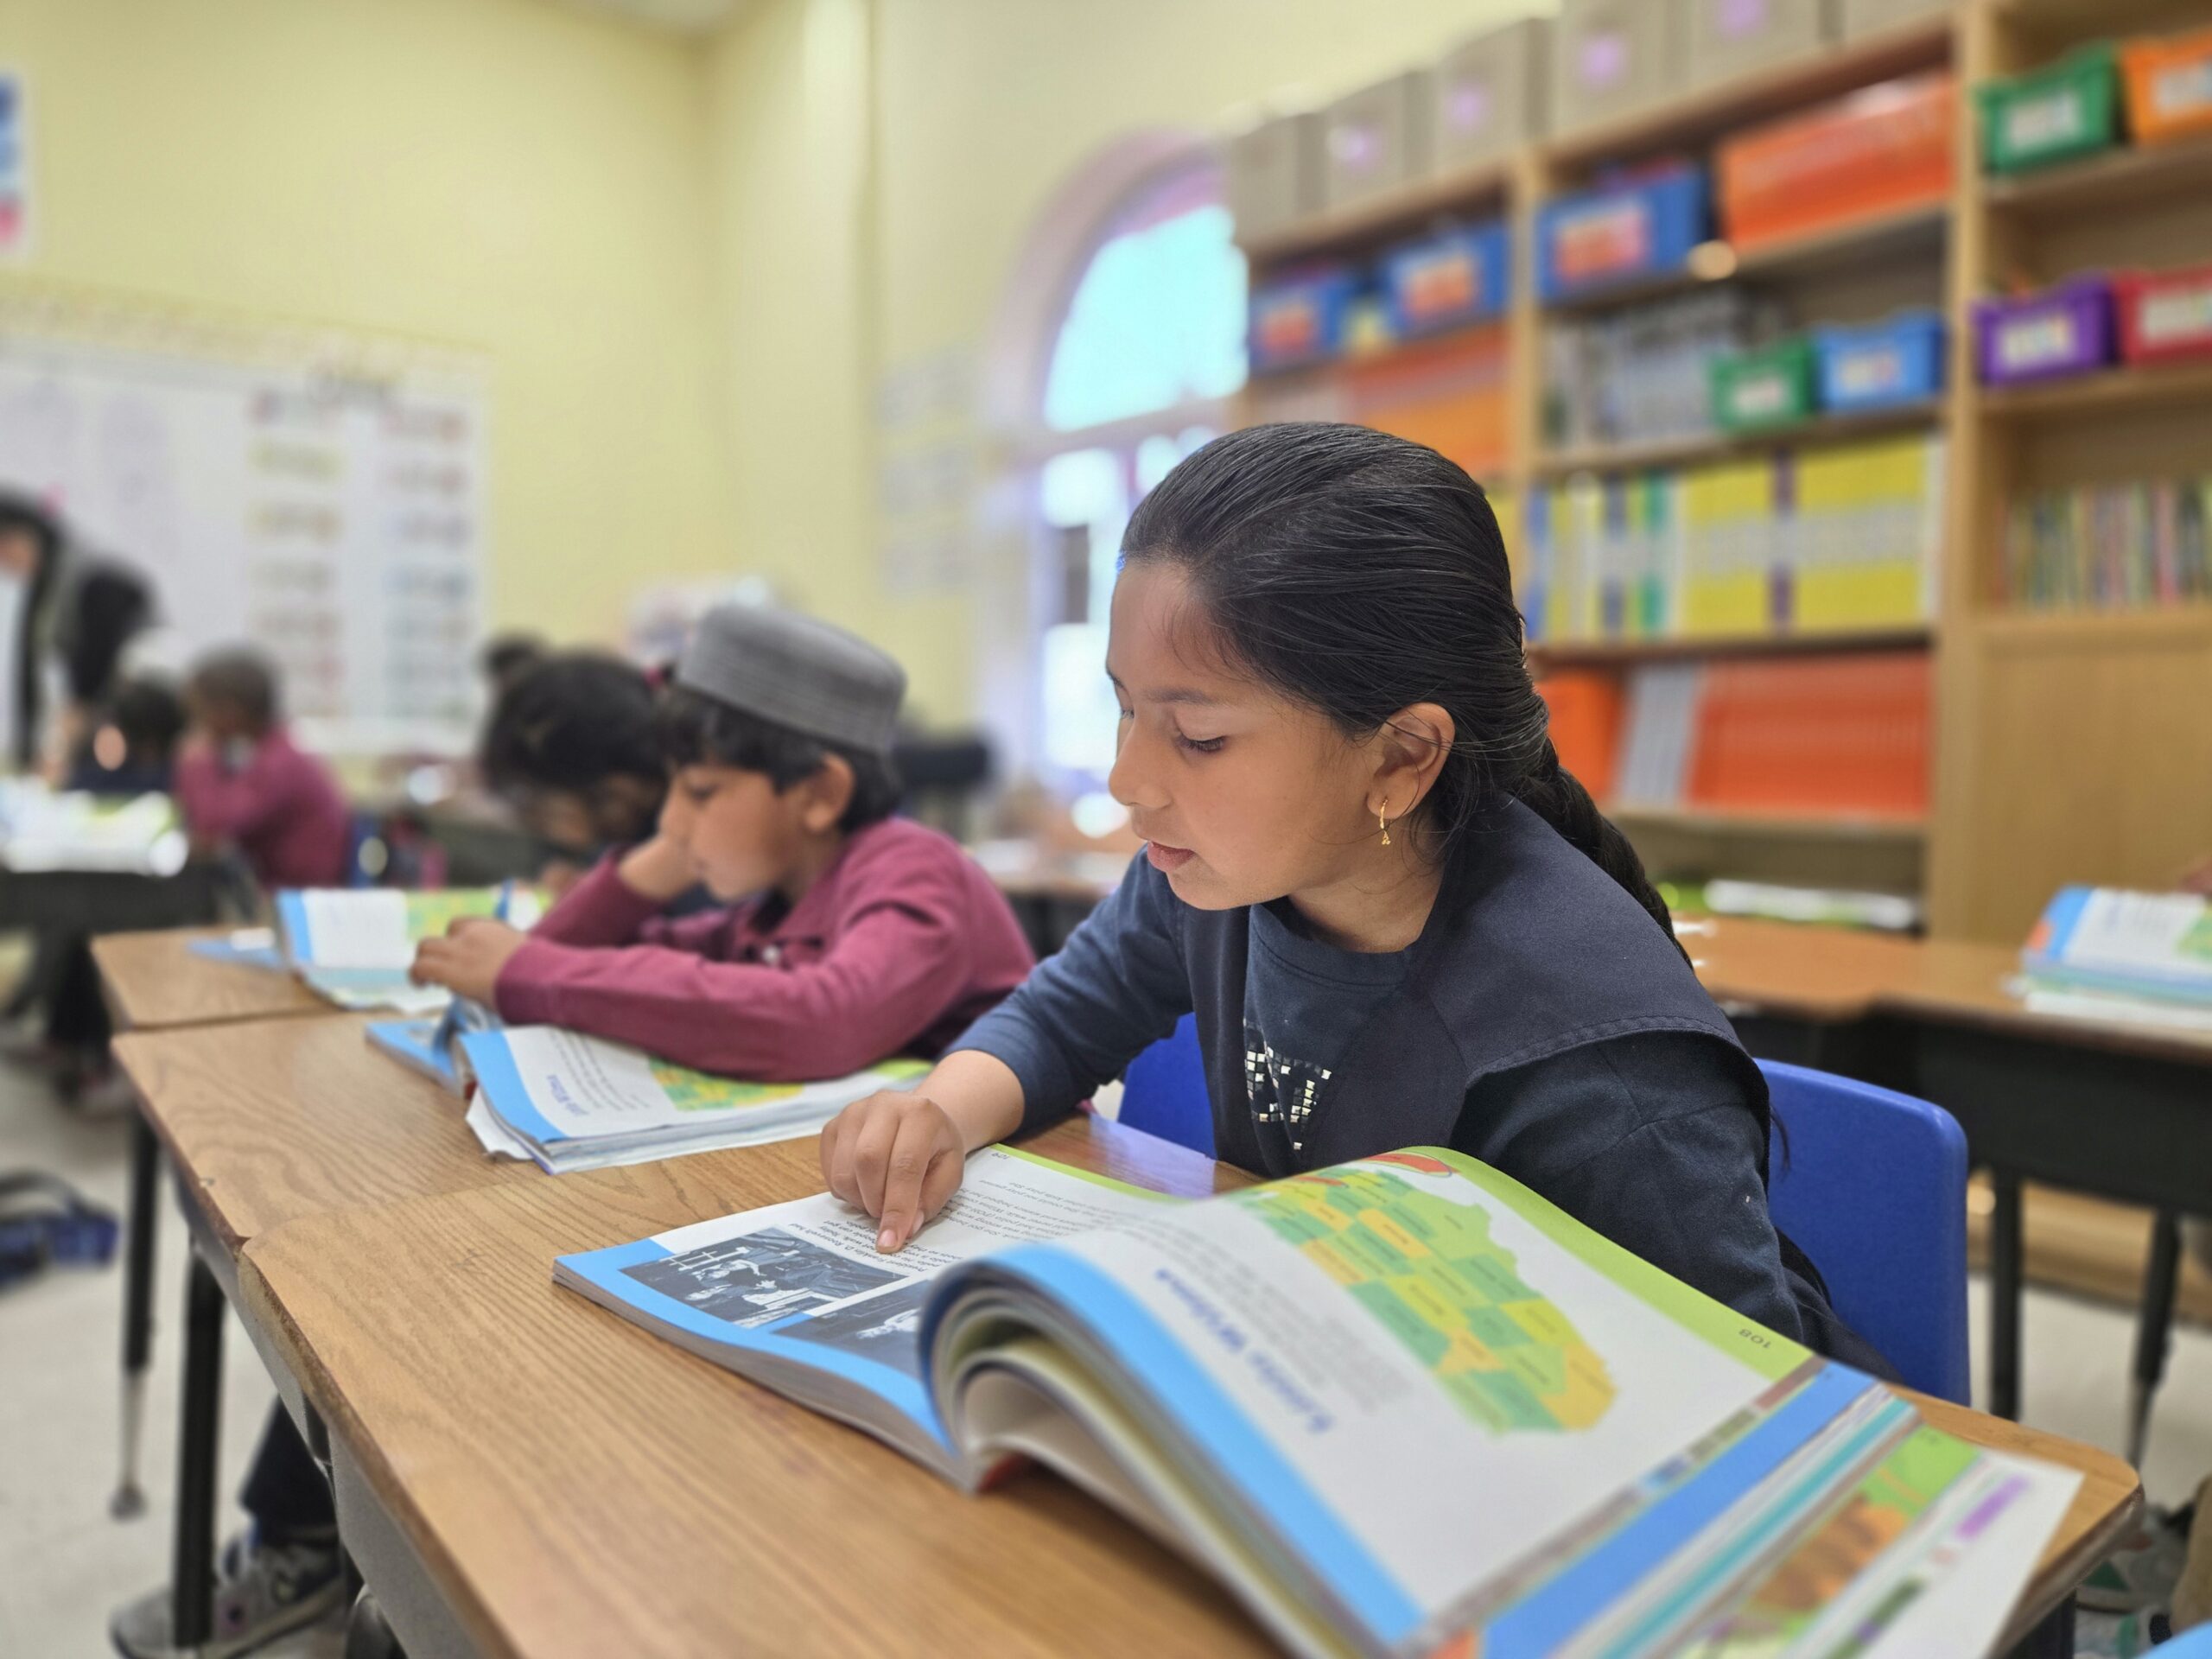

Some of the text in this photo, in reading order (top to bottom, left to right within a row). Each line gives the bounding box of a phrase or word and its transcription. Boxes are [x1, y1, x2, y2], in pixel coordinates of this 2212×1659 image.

[991, 1152, 1009, 1160] 109
[804, 1230, 842, 1246] Roosevelt
[1738, 1328, 1772, 1349] 108
